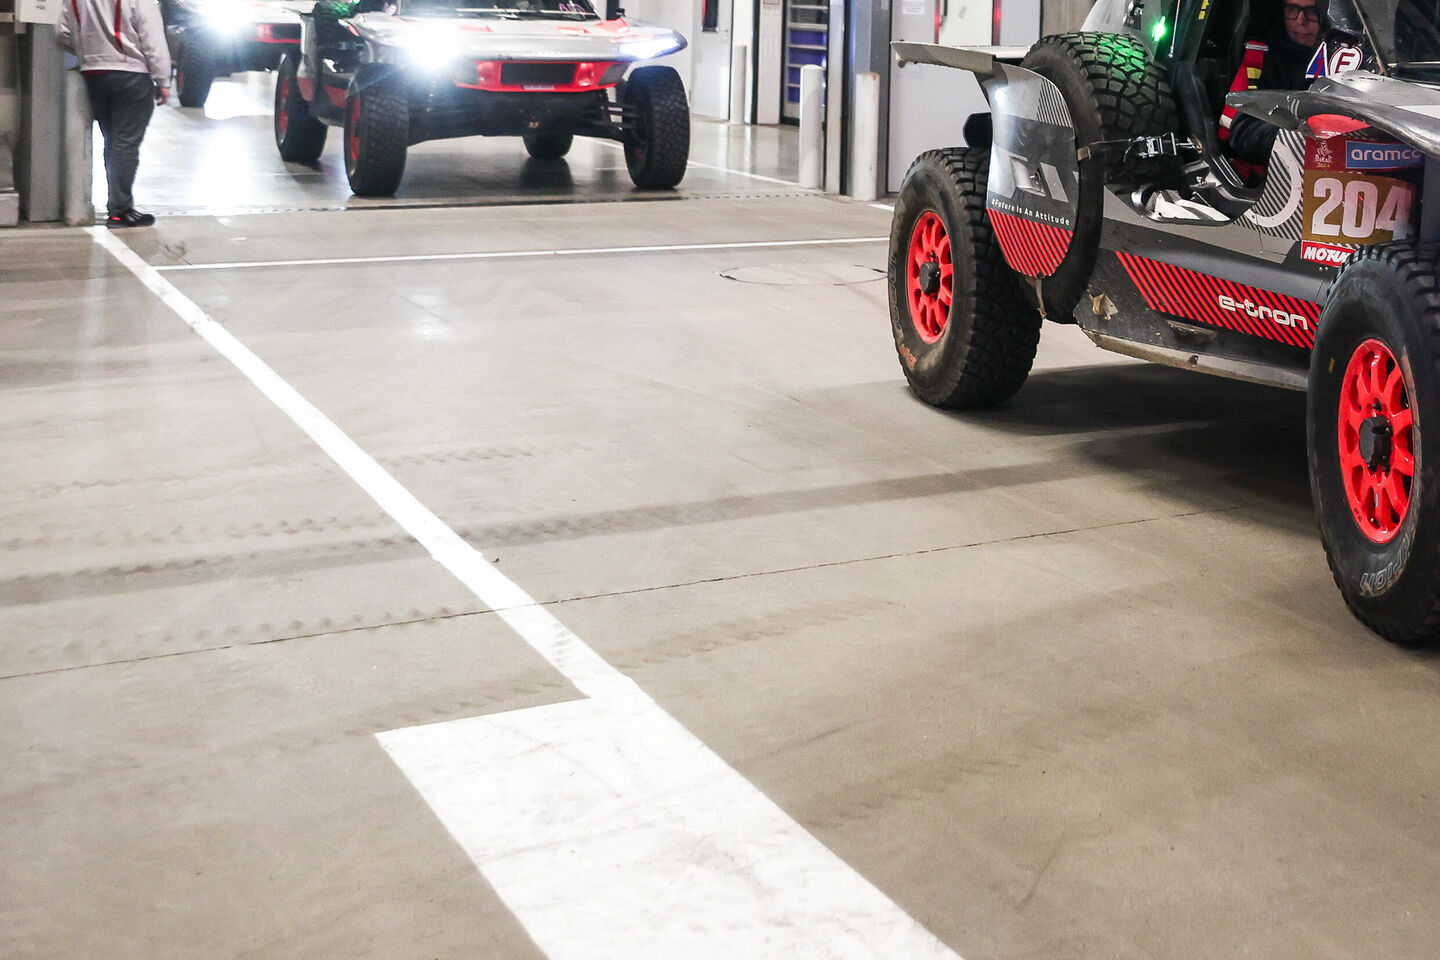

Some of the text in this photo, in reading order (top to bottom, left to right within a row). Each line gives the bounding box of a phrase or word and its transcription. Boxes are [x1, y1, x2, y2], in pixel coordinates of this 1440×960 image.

[1024, 207, 1033, 216] An
[1035, 210, 1070, 226] Attitude
[1311, 177, 1413, 241] 204
[1218, 294, 1309, 331] e-tron
